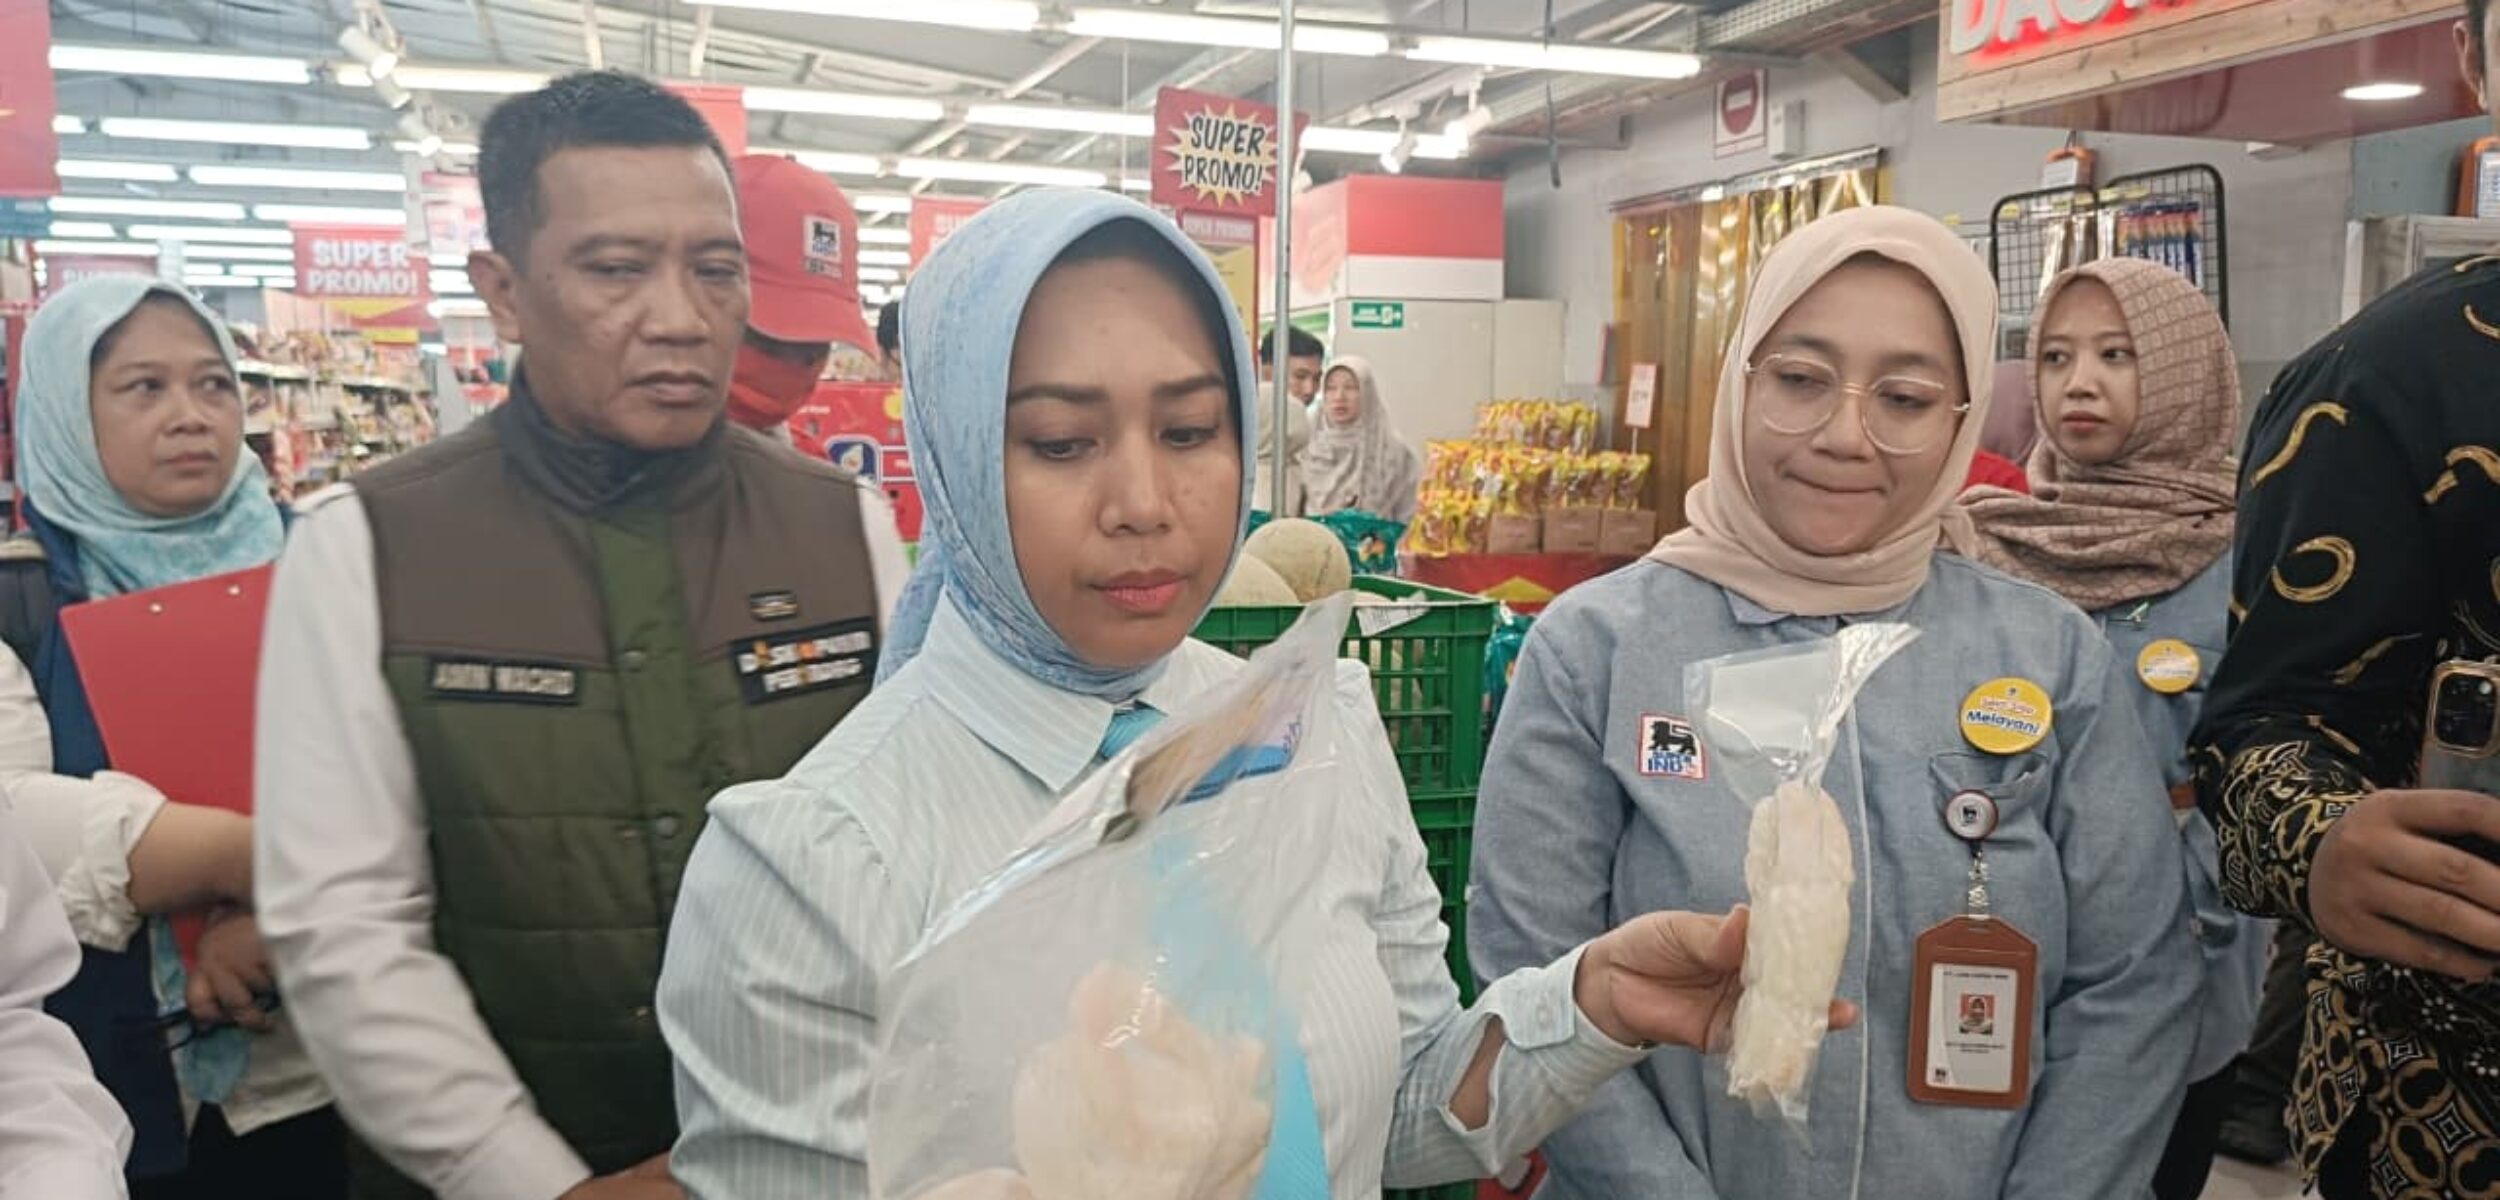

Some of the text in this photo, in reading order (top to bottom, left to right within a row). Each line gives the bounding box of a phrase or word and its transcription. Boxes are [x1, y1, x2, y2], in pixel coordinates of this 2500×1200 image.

[1190, 116, 1265, 157] SUPER
[1184, 154, 1263, 191] PROMO!
[312, 239, 410, 268] SUPER
[307, 268, 419, 295] PROMO!
[1966, 710, 2040, 735] Melayani
